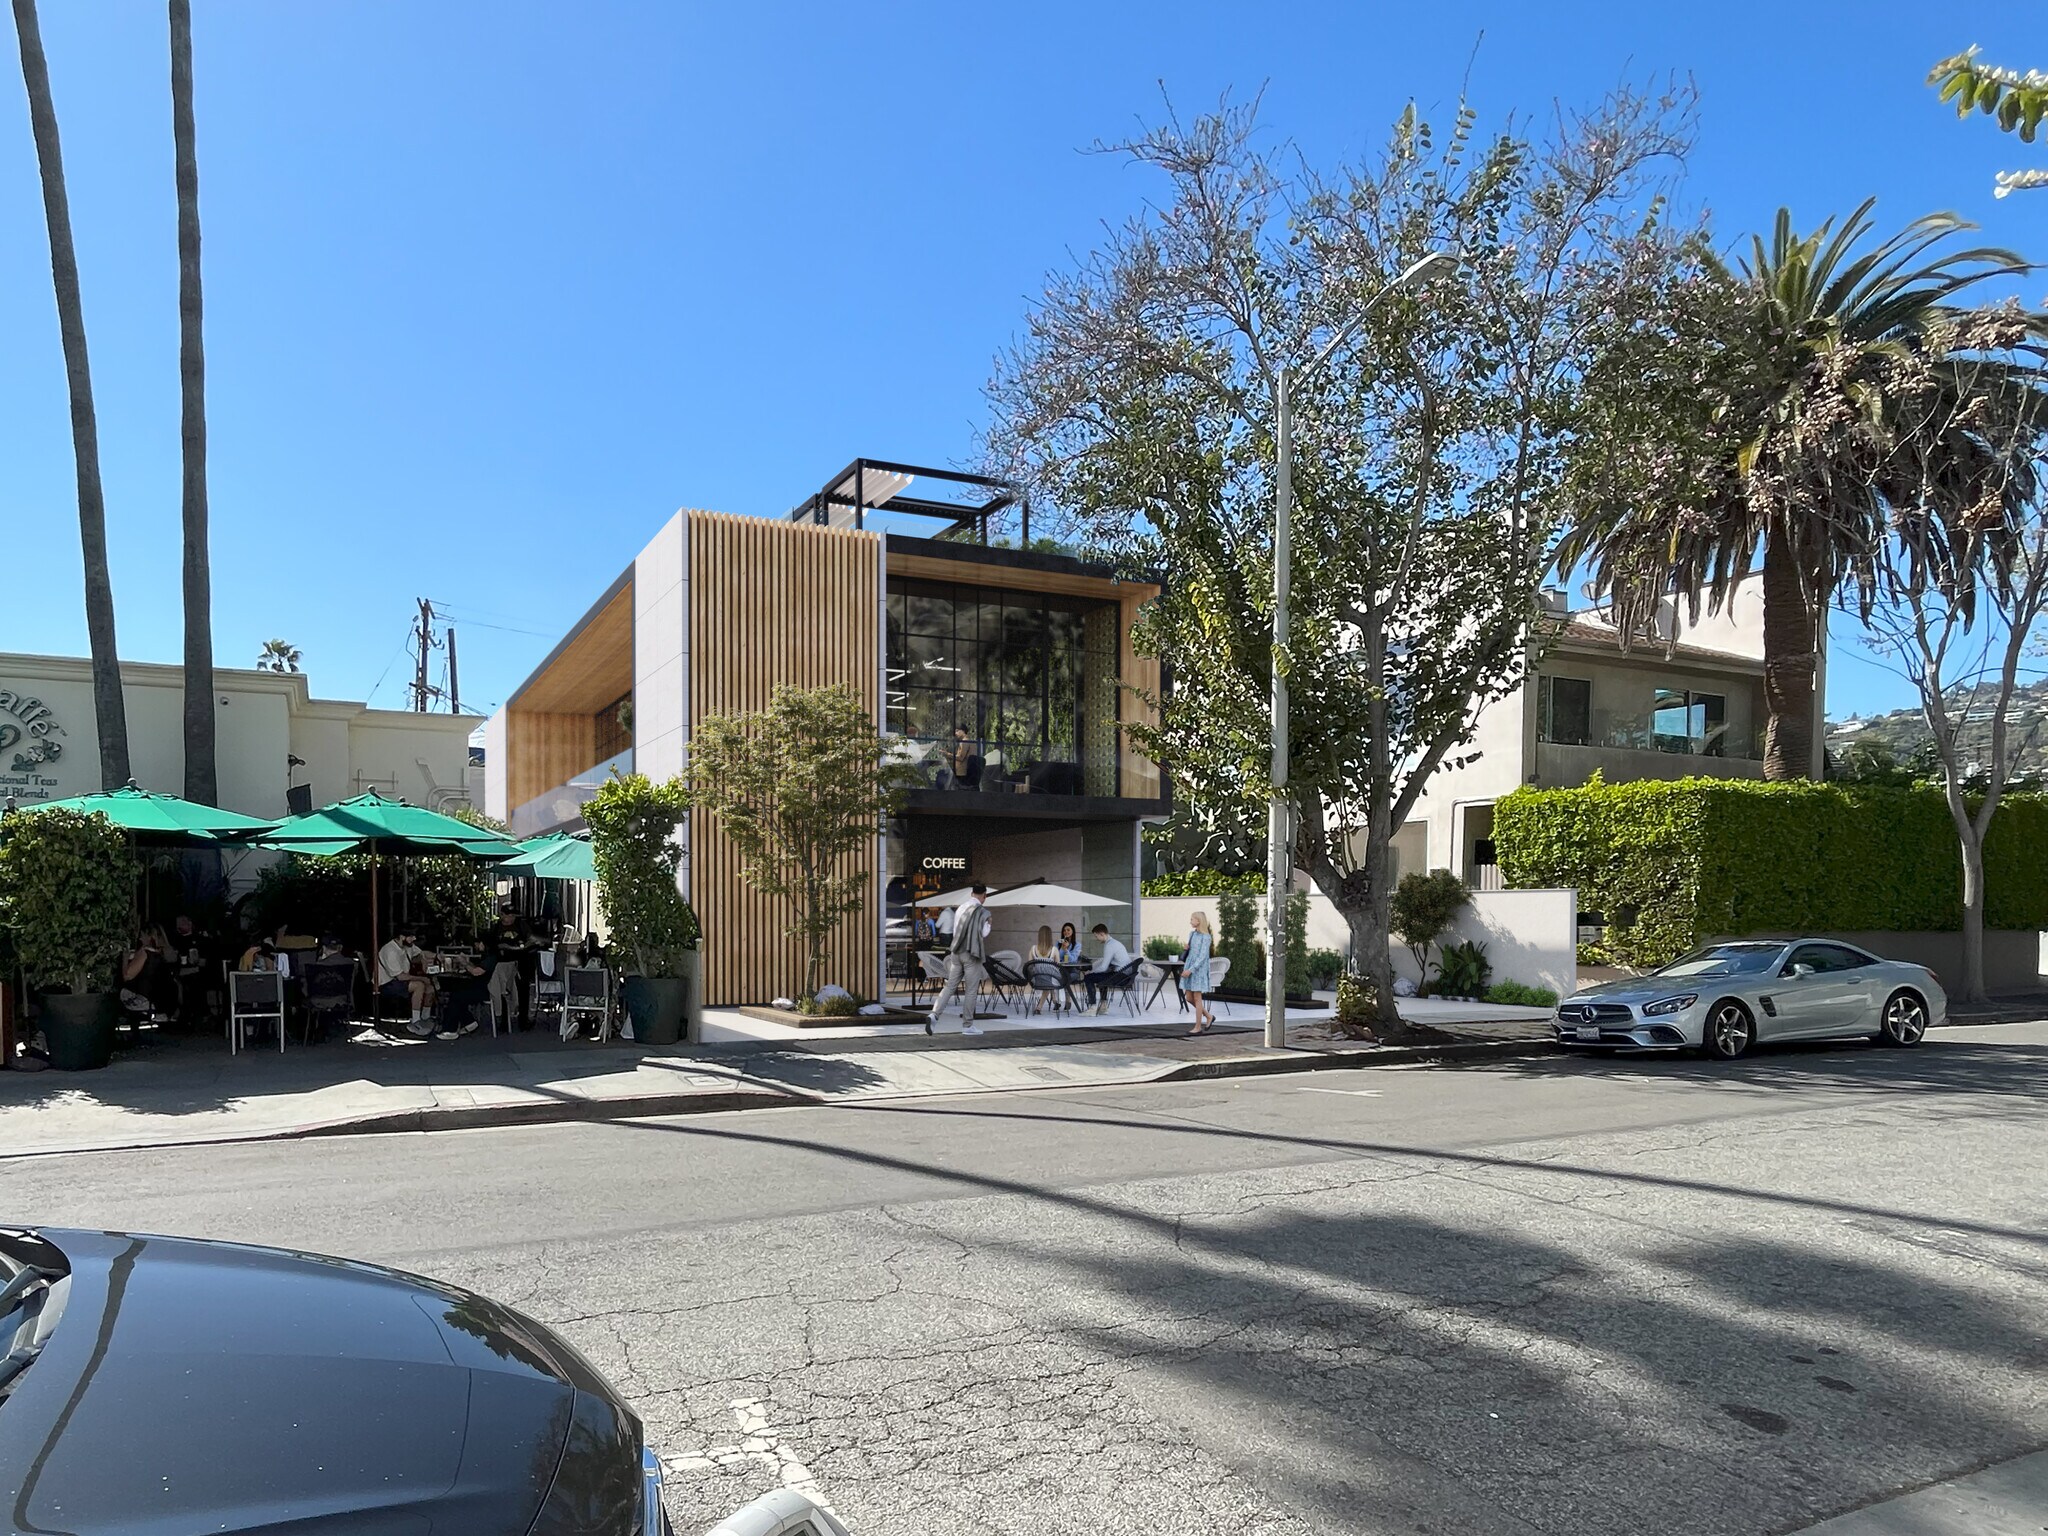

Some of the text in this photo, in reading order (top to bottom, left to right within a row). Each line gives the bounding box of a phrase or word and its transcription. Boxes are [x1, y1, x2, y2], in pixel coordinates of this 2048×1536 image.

[31, 774, 58, 786] Teas
[12, 786, 49, 799] Blends
[922, 857, 966, 869] COFFEE
